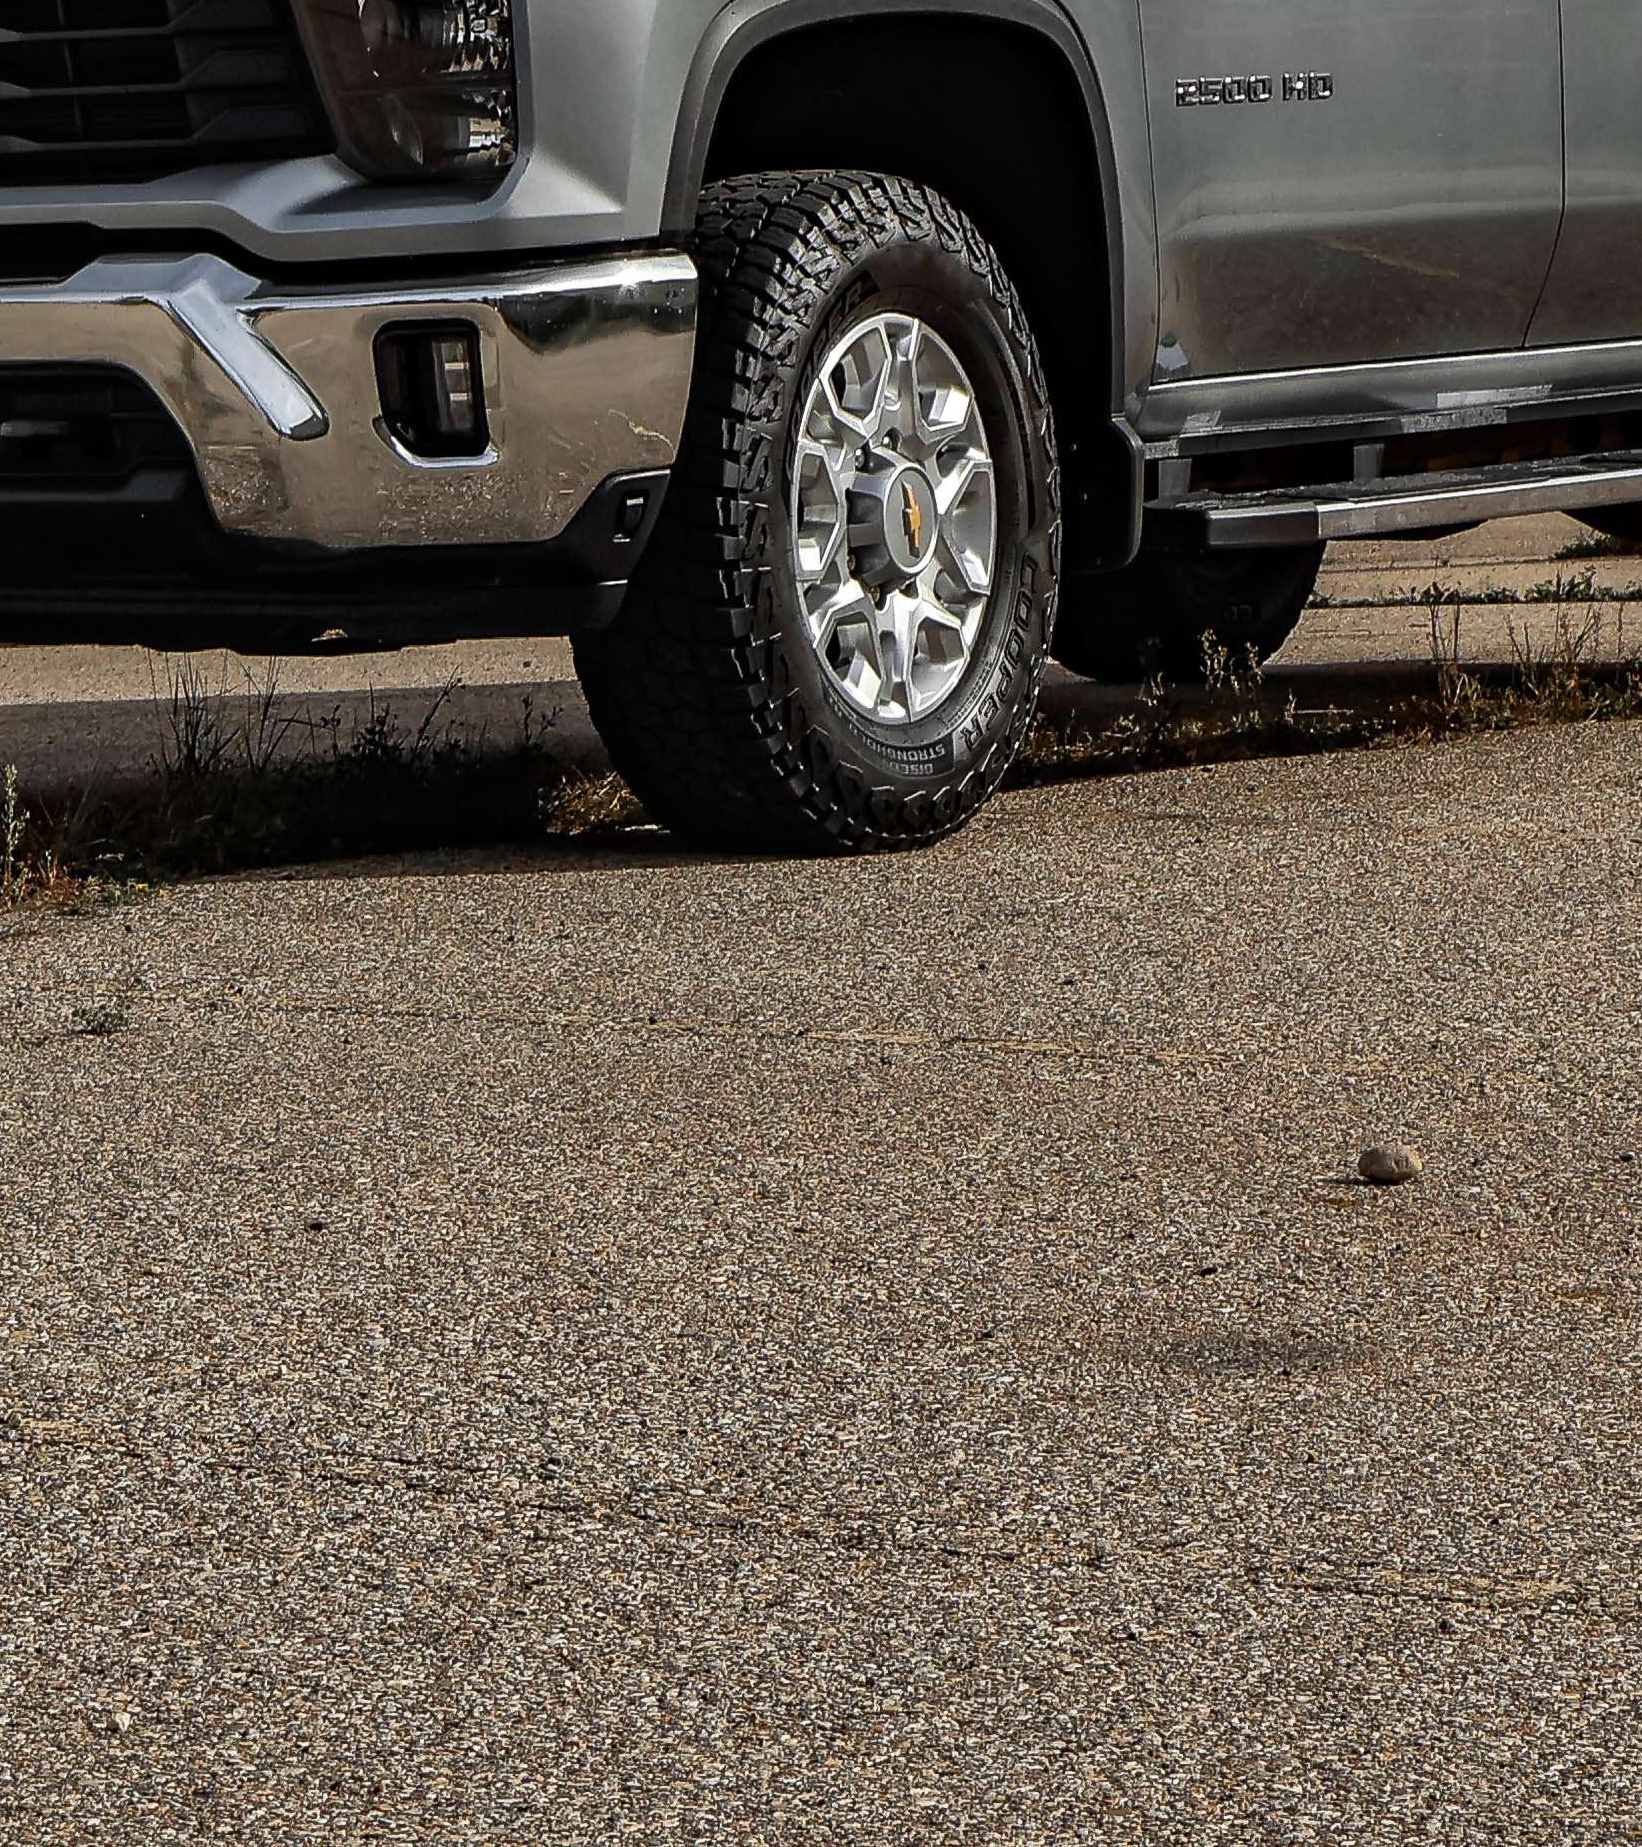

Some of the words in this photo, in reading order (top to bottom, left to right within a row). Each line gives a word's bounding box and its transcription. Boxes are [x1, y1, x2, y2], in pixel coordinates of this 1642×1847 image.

[1175, 76, 1273, 106] 2500
[1282, 71, 1334, 101] HD
[960, 552, 1040, 750] COOPER
